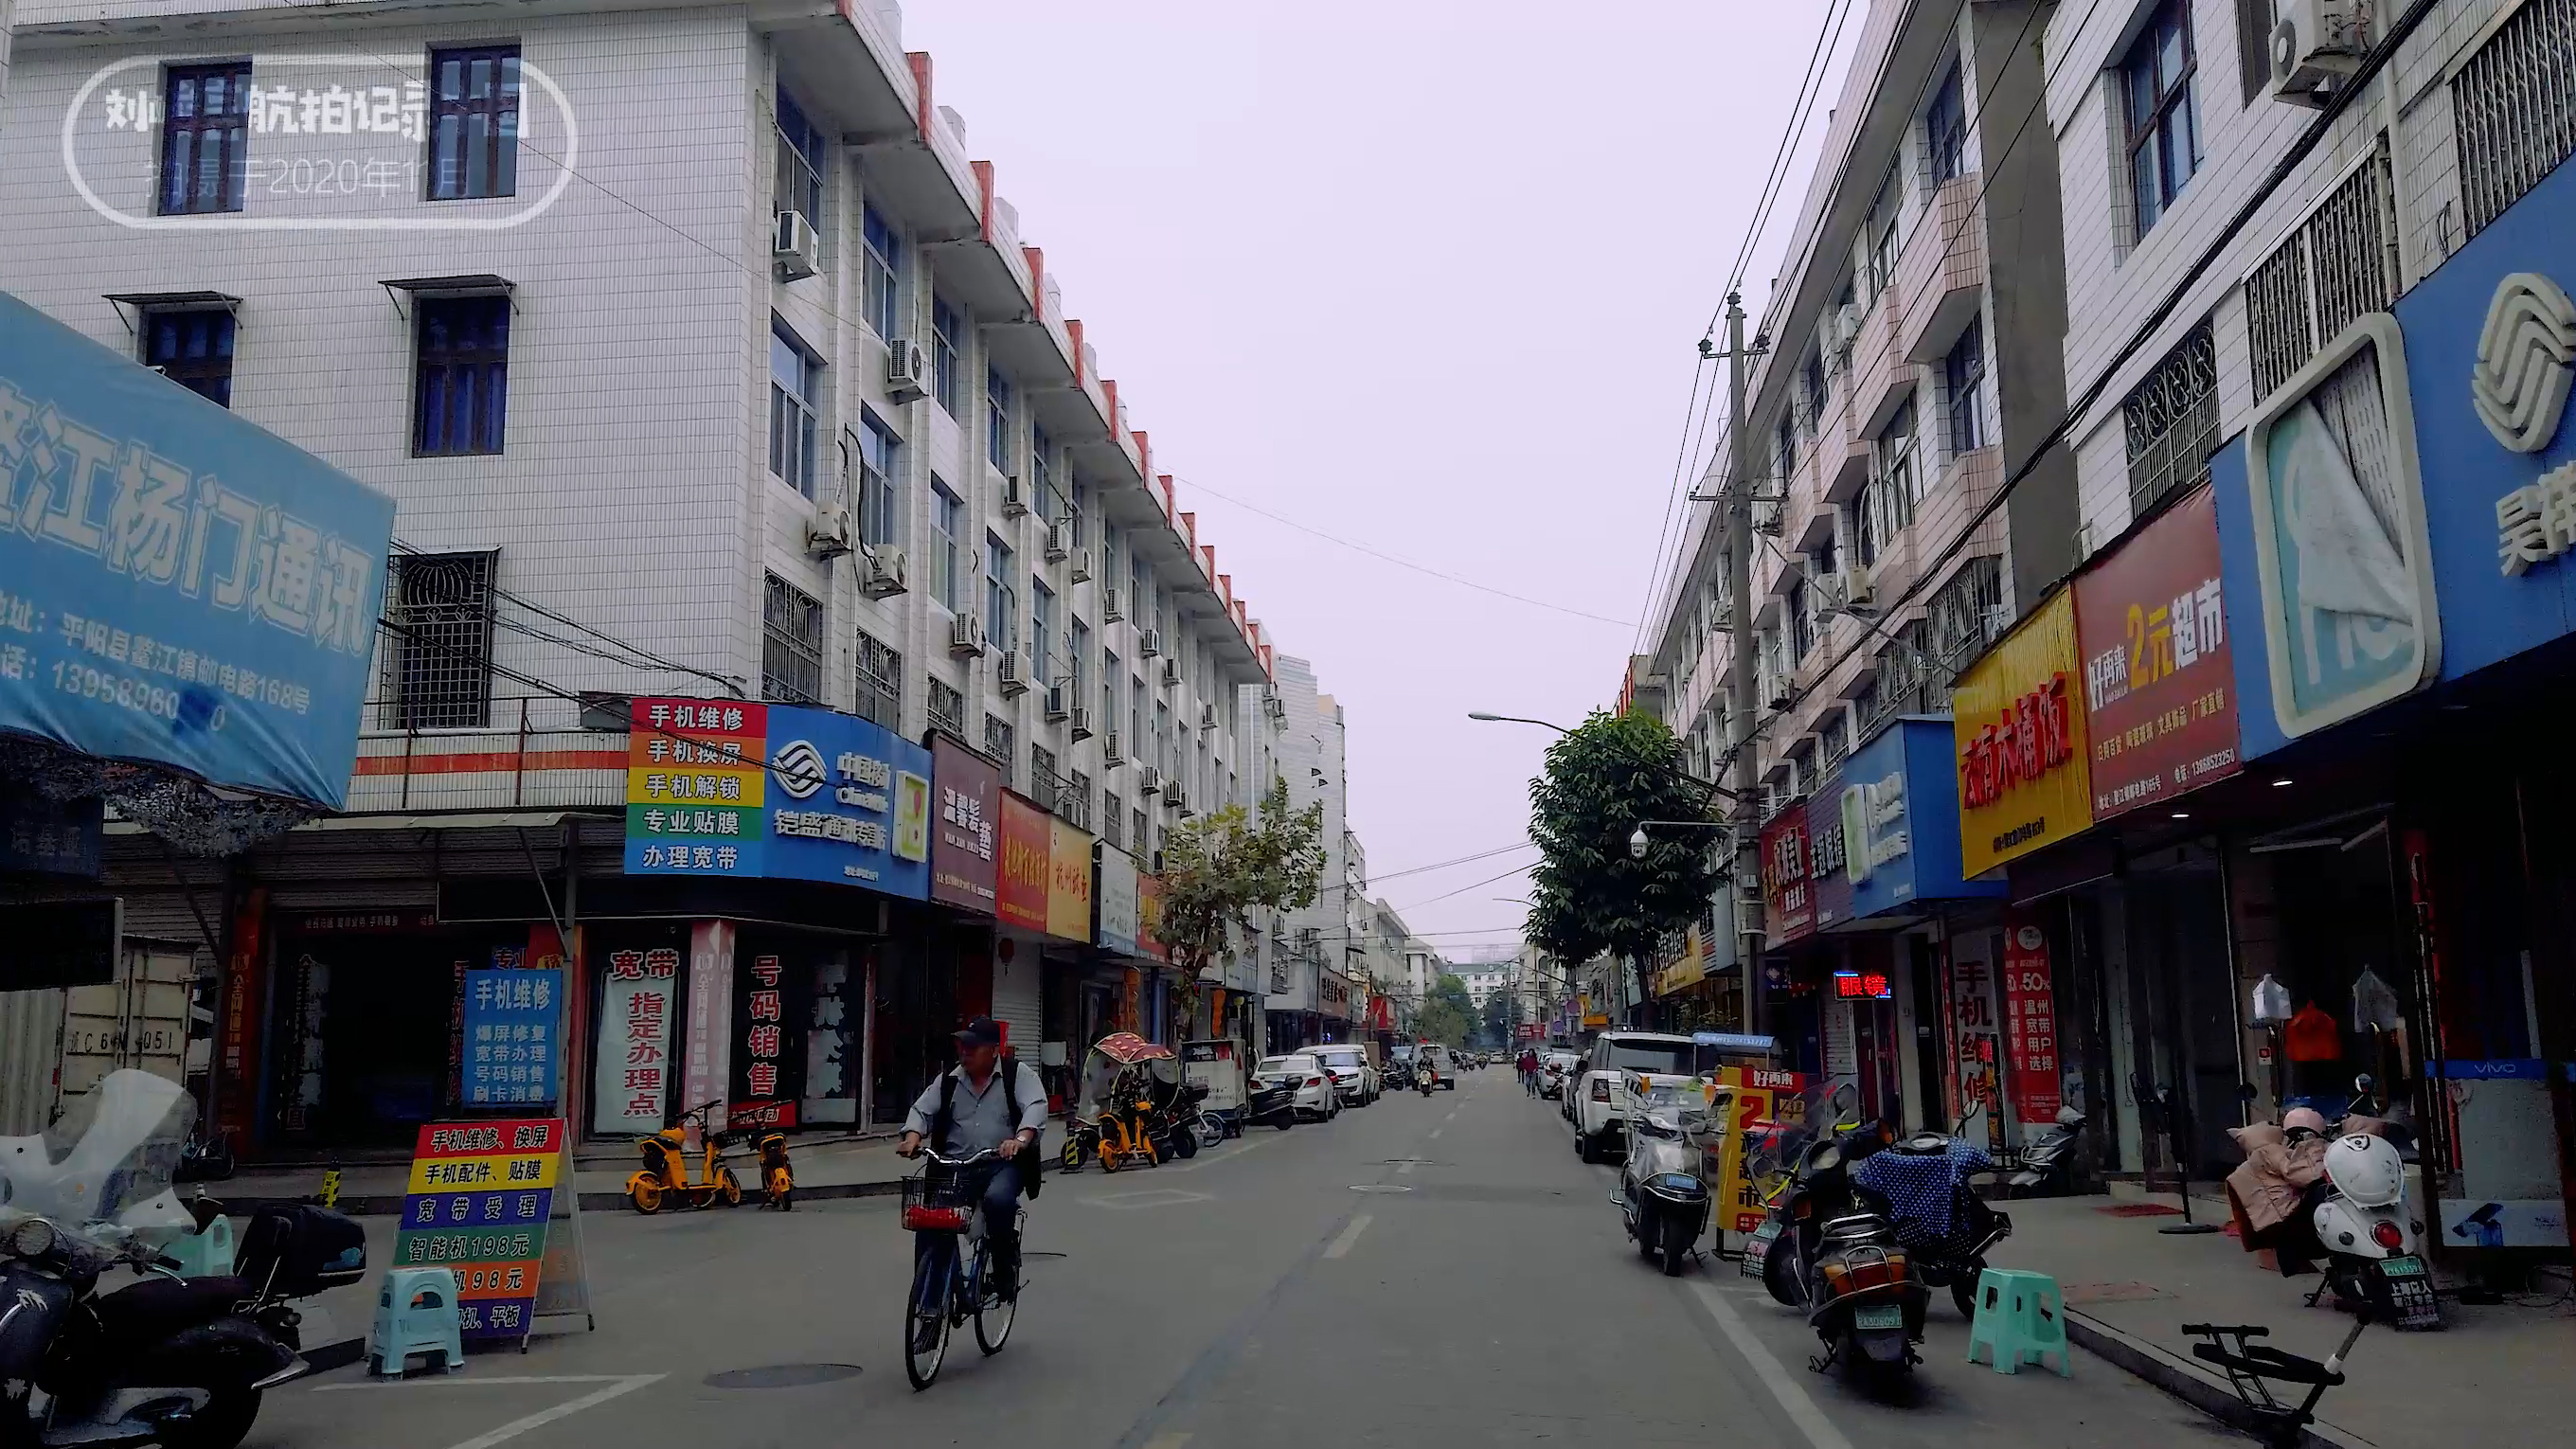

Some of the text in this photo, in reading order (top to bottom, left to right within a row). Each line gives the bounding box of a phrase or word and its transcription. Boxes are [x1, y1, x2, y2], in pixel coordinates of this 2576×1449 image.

[649, 704, 743, 730] 手机维修
[2097, 738, 2123, 762] 日用百货
[2157, 706, 2188, 736] 文具饰品
[2191, 688, 2227, 722] 厂家直销
[647, 739, 742, 765] 手机换屏
[645, 774, 741, 799] 手机解锁
[643, 809, 740, 835] 专业贴膜
[641, 845, 738, 870] 办理宽带
[493, 948, 528, 969] 专业
[611, 949, 679, 979] 宽带
[474, 977, 550, 1011] 手机维修
[1840, 974, 1887, 997] 眼镜
[2023, 998, 2049, 1015] 温州
[475, 1024, 546, 1043] 爆屏修复
[748, 955, 781, 1096] 号码销售
[1956, 960, 1993, 1104] 手机维修
[2025, 1017, 2051, 1033] 宽带
[475, 1046, 546, 1063] 宽带办理
[623, 992, 666, 1118] 指定办理点
[2027, 1037, 2053, 1053] 用户
[474, 1065, 546, 1083] 号码销售
[2028, 1055, 2054, 1072] 选择
[2474, 1062, 2516, 1074] vivo
[1753, 1069, 1794, 1087] 好再来
[473, 1085, 545, 1102] 刷卡消费
[431, 1125, 549, 1152] 手机维修、换屏
[425, 1158, 543, 1185] 手机配件、贴膜
[408, 1233, 529, 1261] 智能机198元
